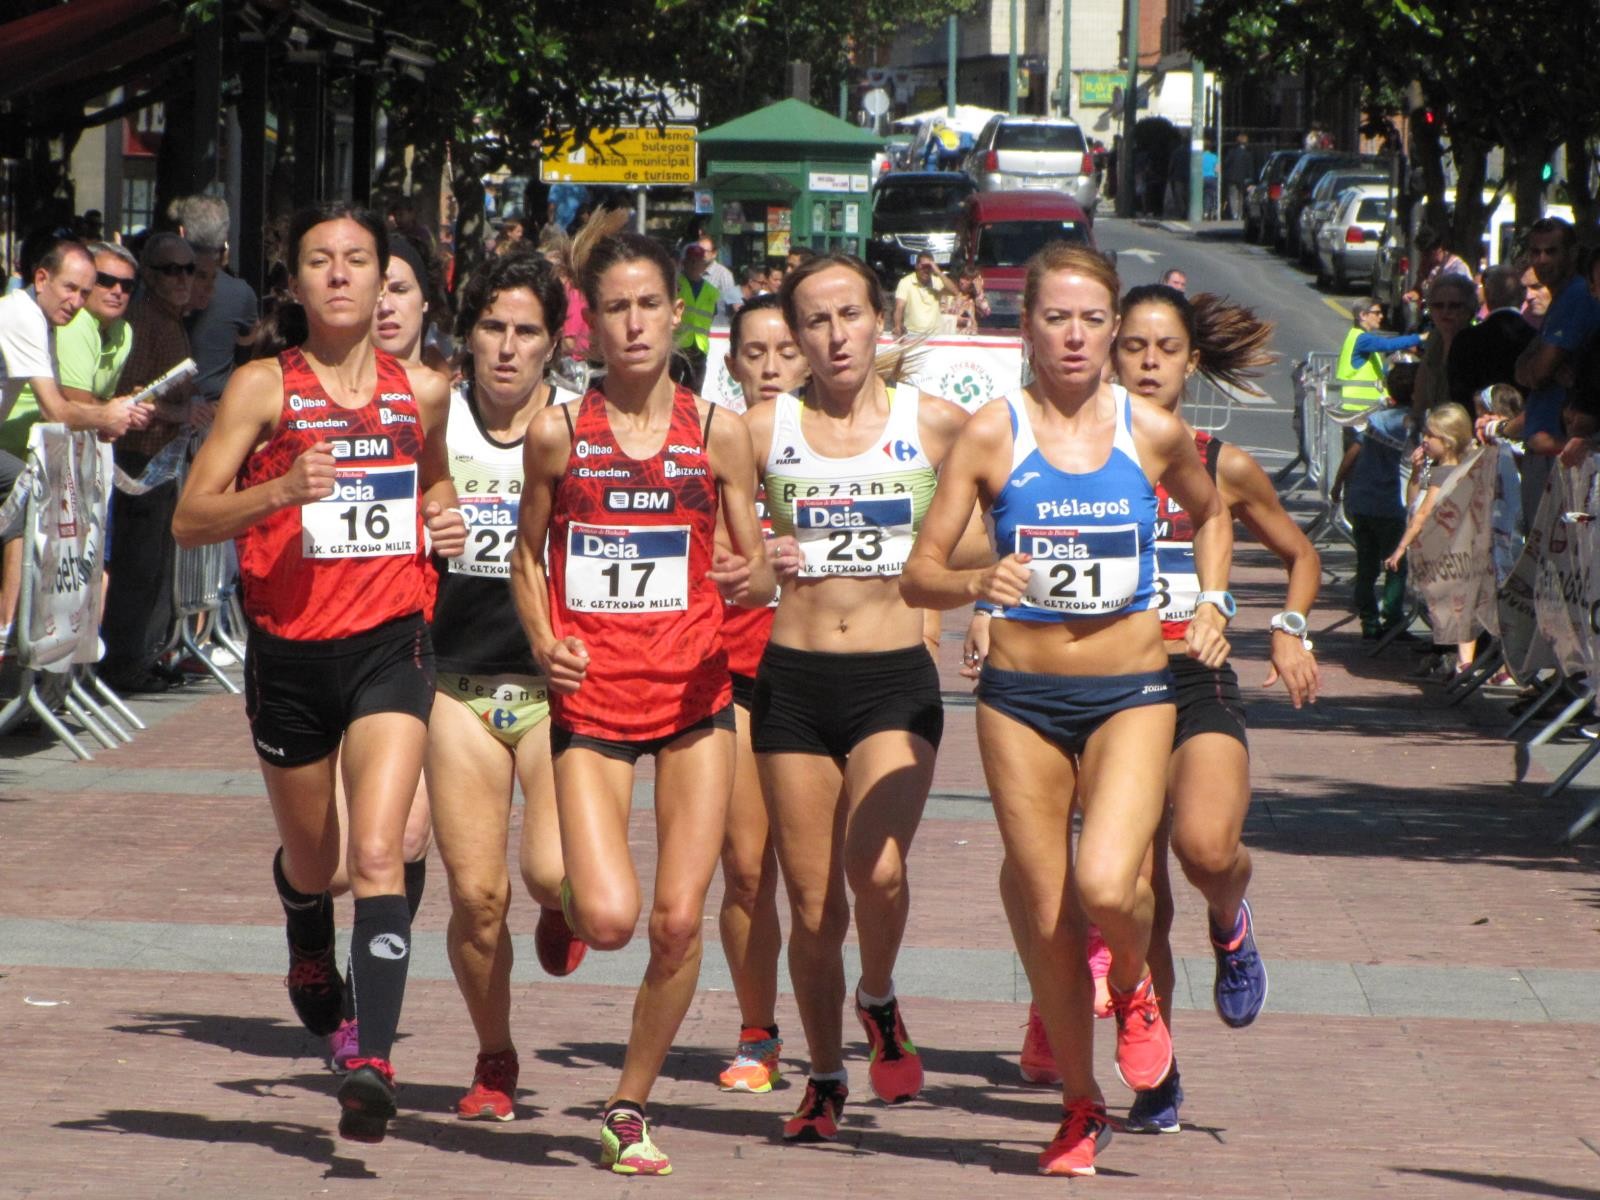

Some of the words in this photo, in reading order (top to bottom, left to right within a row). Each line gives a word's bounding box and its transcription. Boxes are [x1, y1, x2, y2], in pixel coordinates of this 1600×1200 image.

[645, 131, 690, 140] tusmo
[642, 142, 690, 153] bulegoa
[633, 156, 690, 168] municipal
[624, 170, 639, 180] de
[644, 170, 690, 180] turismo
[290, 394, 327, 411] Bilbao
[296, 418, 348, 430] Guedan
[355, 438, 388, 457] BM
[576, 440, 613, 458] Bilbao
[578, 467, 630, 478] Guedan
[676, 467, 706, 477] BIZKAIA
[632, 491, 669, 510] BM
[340, 503, 390, 541] 16
[461, 503, 512, 525] Deia
[809, 506, 866, 528] Deia
[1154, 521, 1169, 537] M
[583, 534, 639, 559] Deia
[826, 529, 883, 562] 23
[1032, 537, 1090, 559] Deia
[601, 562, 656, 597] 17
[1049, 563, 1101, 598] 21
[650, 597, 682, 609] MILIA
[458, 676, 546, 702] Bezana
